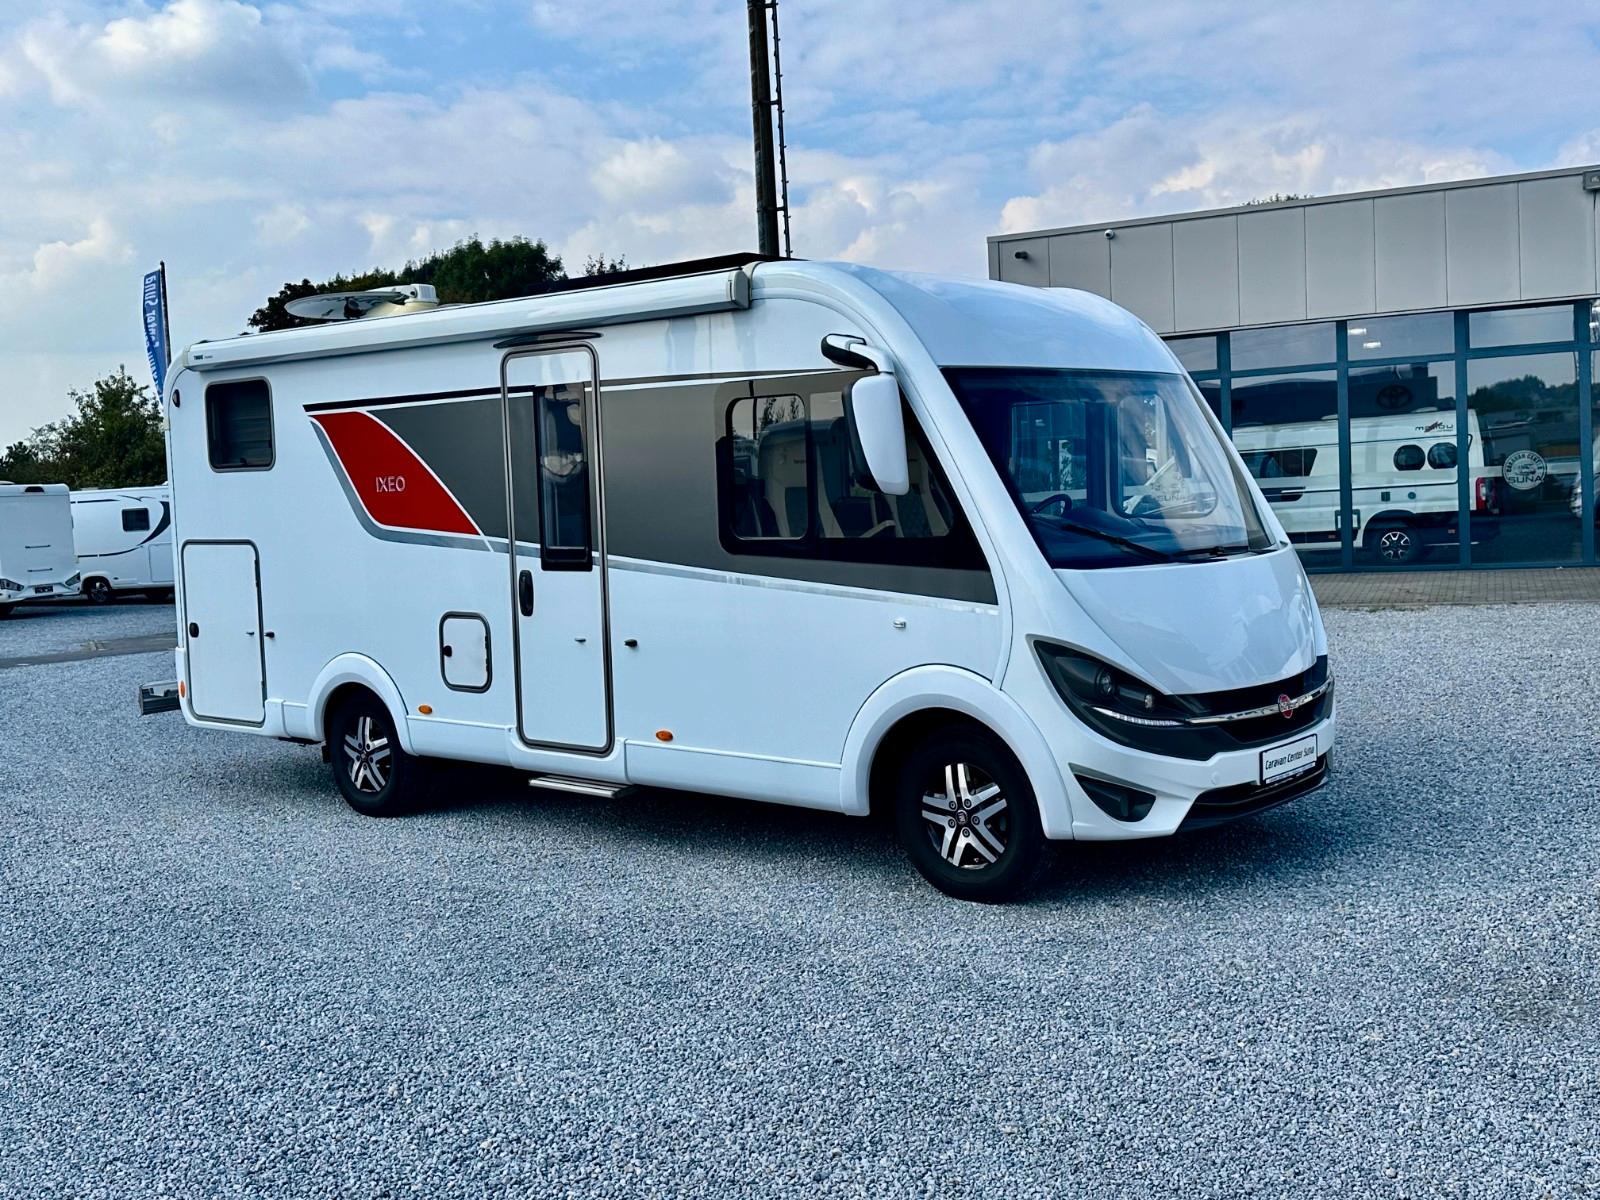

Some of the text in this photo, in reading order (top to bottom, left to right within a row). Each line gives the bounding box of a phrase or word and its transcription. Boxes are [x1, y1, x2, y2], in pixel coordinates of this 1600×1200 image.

[375, 475, 406, 493] IXEO
[1508, 475, 1542, 484] SUNA
[1265, 756, 1287, 770] Caravan
[1287, 750, 1303, 763] Center
